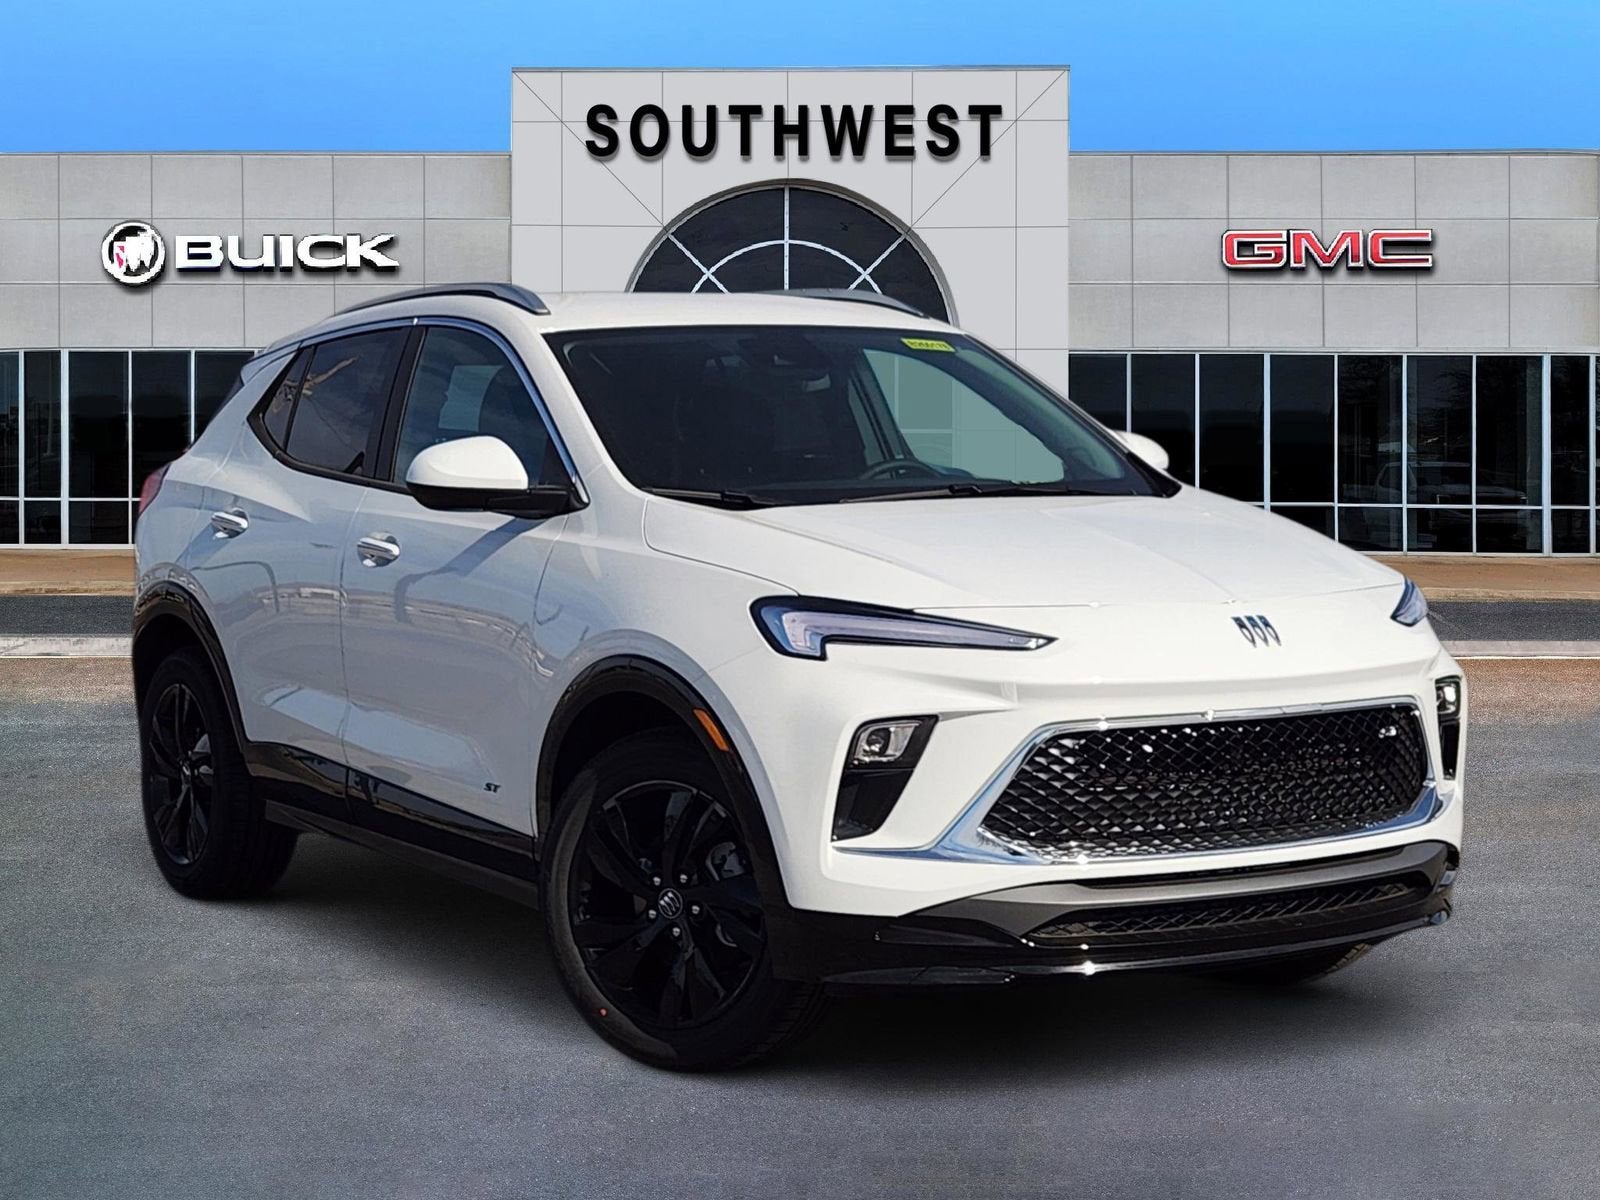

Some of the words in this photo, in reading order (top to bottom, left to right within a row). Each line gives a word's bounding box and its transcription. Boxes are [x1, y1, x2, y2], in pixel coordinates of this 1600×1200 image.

[585, 104, 1003, 158] SOUTHWEST
[175, 233, 400, 270] BUICK
[1221, 229, 1433, 269] GMC
[483, 782, 502, 793] ST
